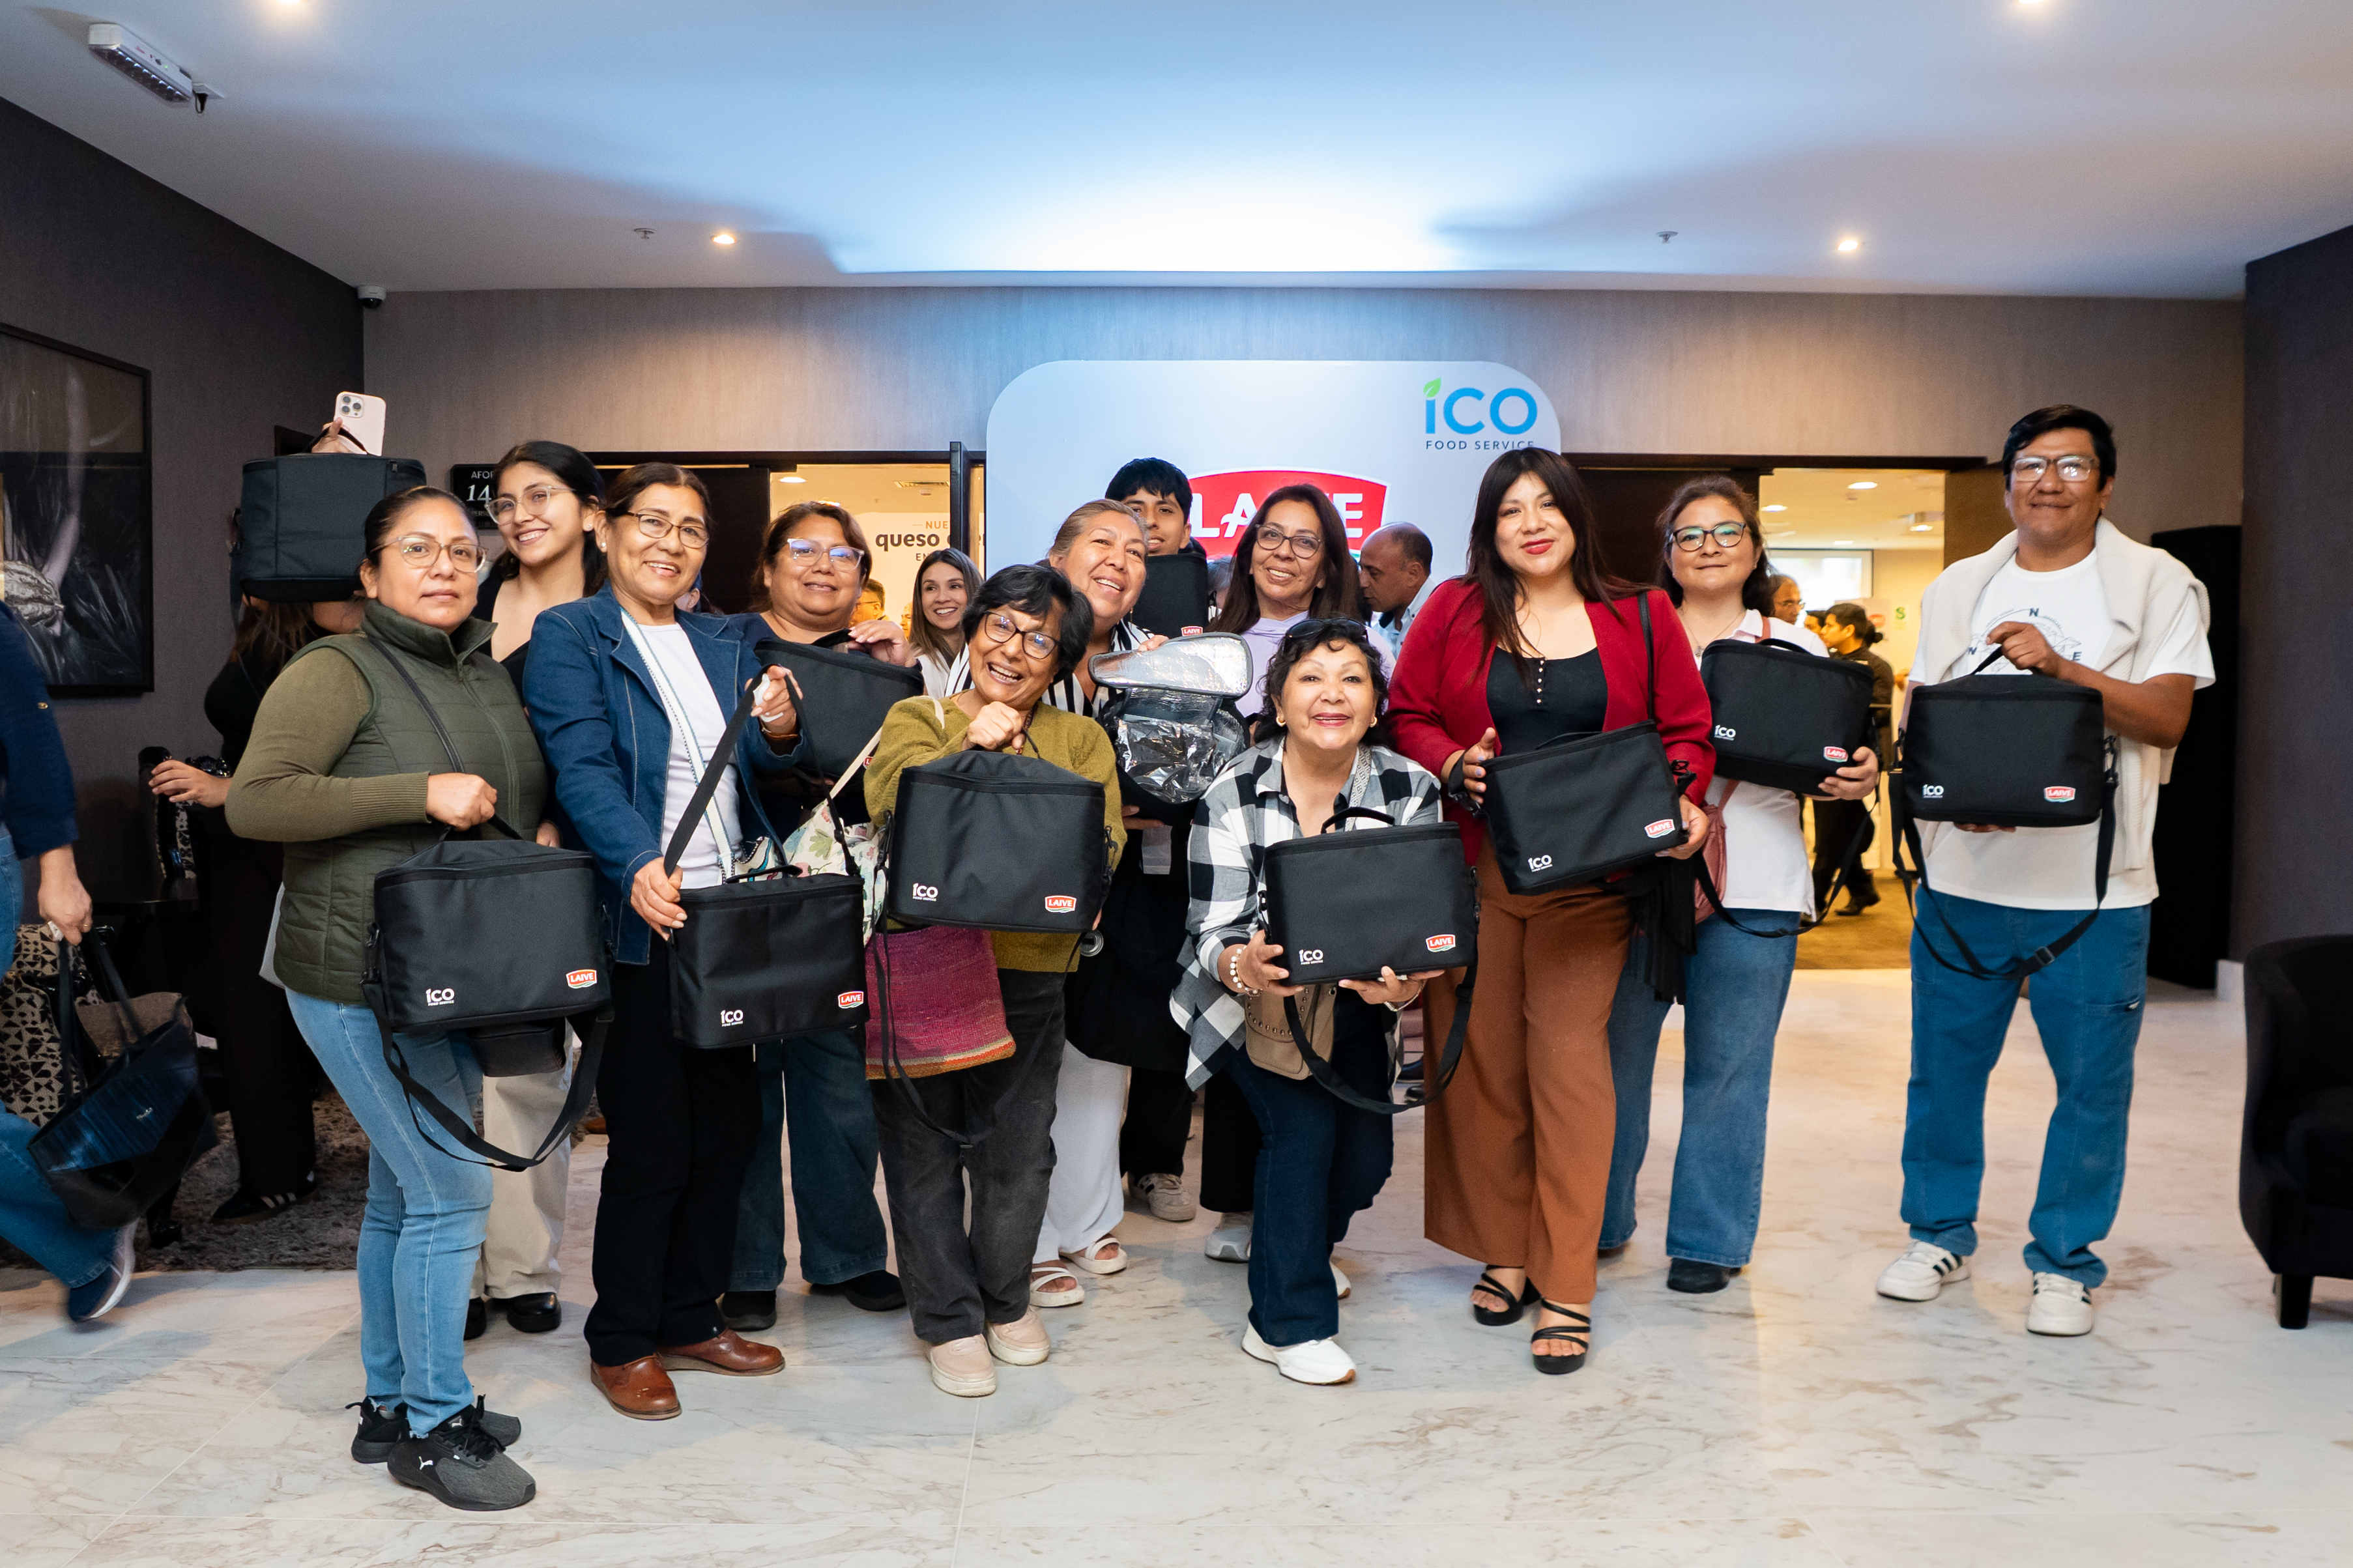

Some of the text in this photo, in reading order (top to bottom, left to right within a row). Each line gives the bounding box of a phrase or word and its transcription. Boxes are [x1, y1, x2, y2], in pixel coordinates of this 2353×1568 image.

[1426, 440, 1534, 449] FOOD SERVICE
[467, 484, 492, 502] 14
[1190, 493, 1363, 538] LAE
[876, 534, 940, 552] queso
[2029, 608, 2039, 617] N
[1649, 821, 1671, 833] LAIVE
[1429, 937, 1452, 947] LAIVE
[570, 973, 594, 982] LAIVE
[841, 994, 861, 1003] LAIVE
